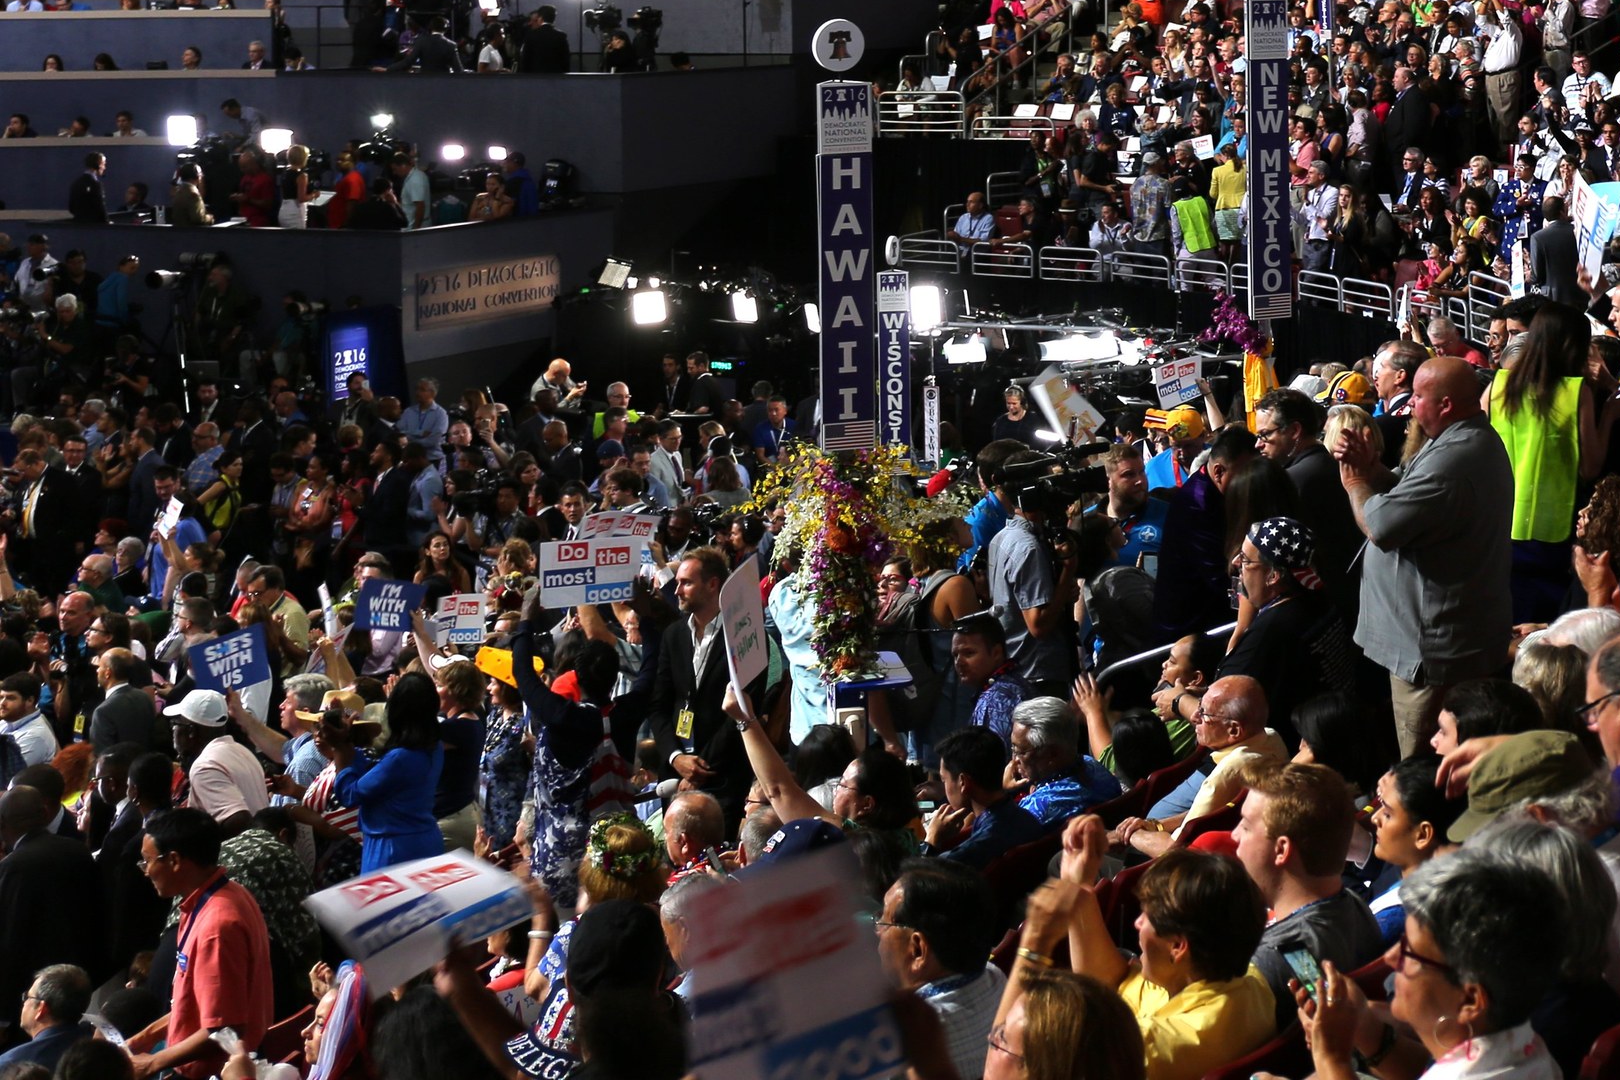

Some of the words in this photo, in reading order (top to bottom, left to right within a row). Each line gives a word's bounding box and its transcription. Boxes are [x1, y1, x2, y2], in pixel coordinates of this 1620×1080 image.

[1256, 63, 1283, 134] NEW
[824, 129, 866, 137] NATIONAL
[825, 121, 866, 129] DEMOCRATIC
[825, 136, 867, 144] CONVENTION
[1260, 148, 1282, 293] MEXICO
[467, 258, 560, 289] DEMOCRATIC
[824, 157, 870, 420] HAWAII
[419, 297, 477, 319] NATIONAL
[484, 284, 560, 311] CONVENTION
[1162, 365, 1175, 379] Do
[1179, 364, 1194, 377] the
[1160, 381, 1180, 397] most
[634, 522, 653, 536] the
[559, 543, 587, 561] Do
[596, 547, 630, 566] the
[381, 584, 404, 598] I'M
[544, 568, 594, 587] most
[586, 584, 634, 604] good
[370, 600, 407, 614] WITH
[458, 602, 479, 614] the
[370, 612, 401, 627] HER
[450, 630, 481, 643] good
[203, 632, 253, 662] SHE'S
[208, 648, 253, 677] WITH
[221, 669, 244, 688] US
